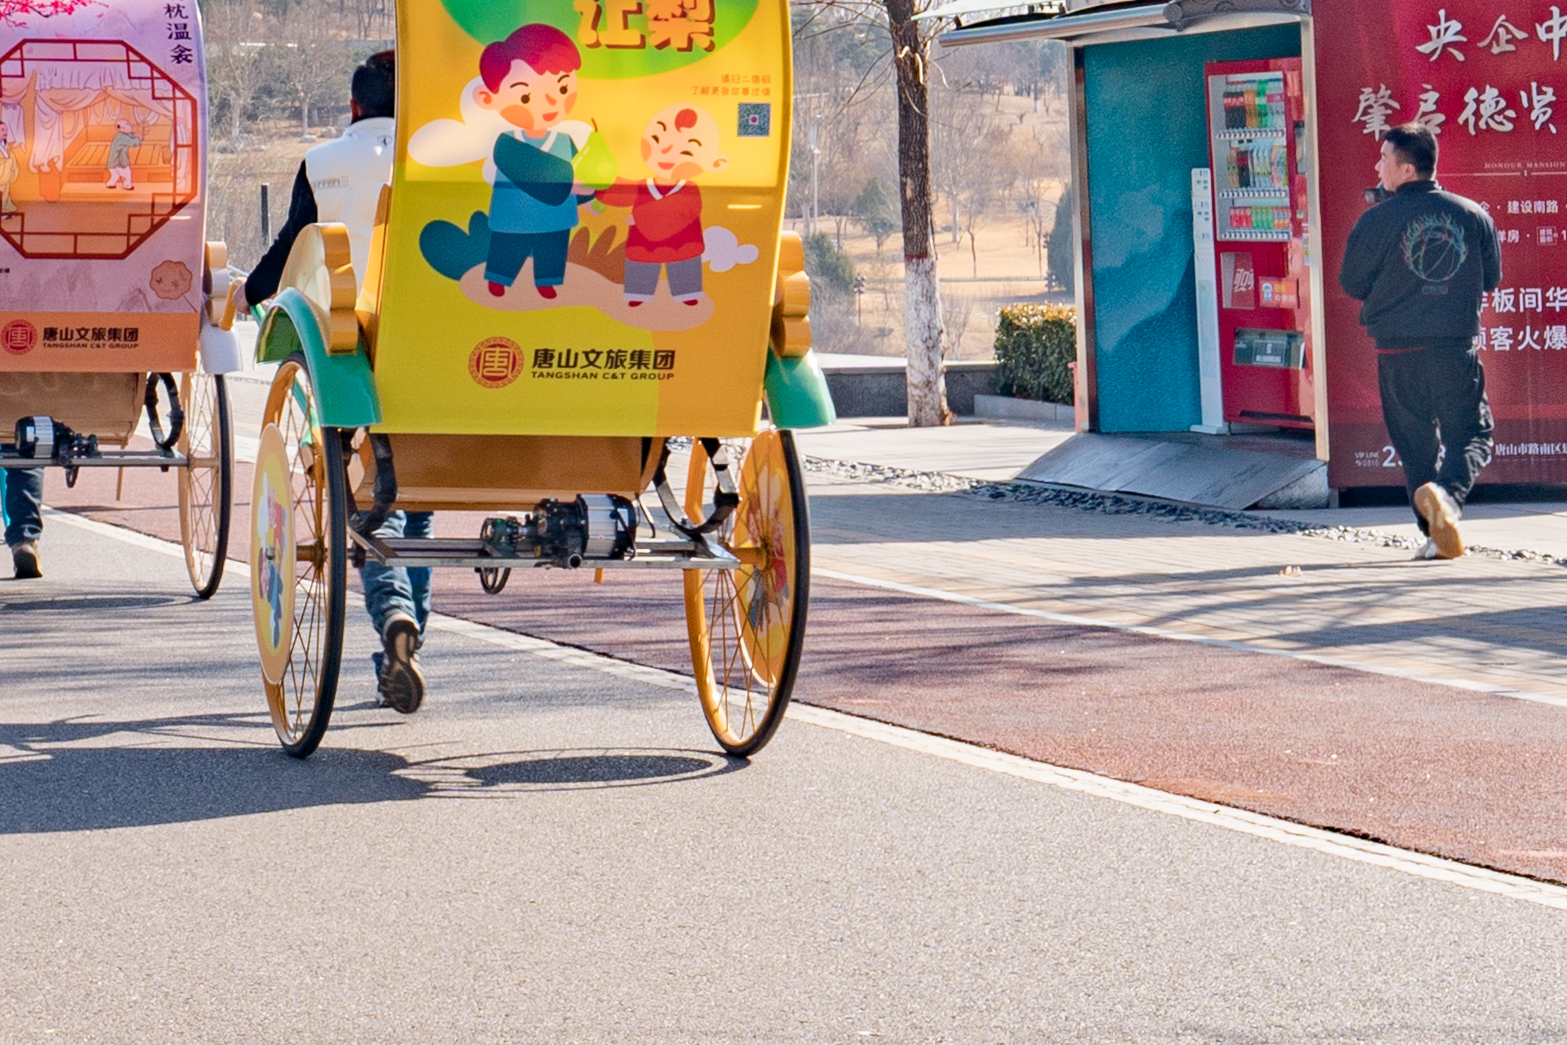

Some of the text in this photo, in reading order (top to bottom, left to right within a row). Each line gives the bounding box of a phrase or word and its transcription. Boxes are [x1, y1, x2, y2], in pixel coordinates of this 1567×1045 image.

[1507, 199, 1559, 214] 建设南路
[42, 327, 139, 342] 唐山文旅集团
[532, 348, 675, 370] 唐山文旅集团
[531, 370, 674, 381] TANGSHAN C&T GROUP
[1495, 442, 1567, 457] 唐山市路南区
